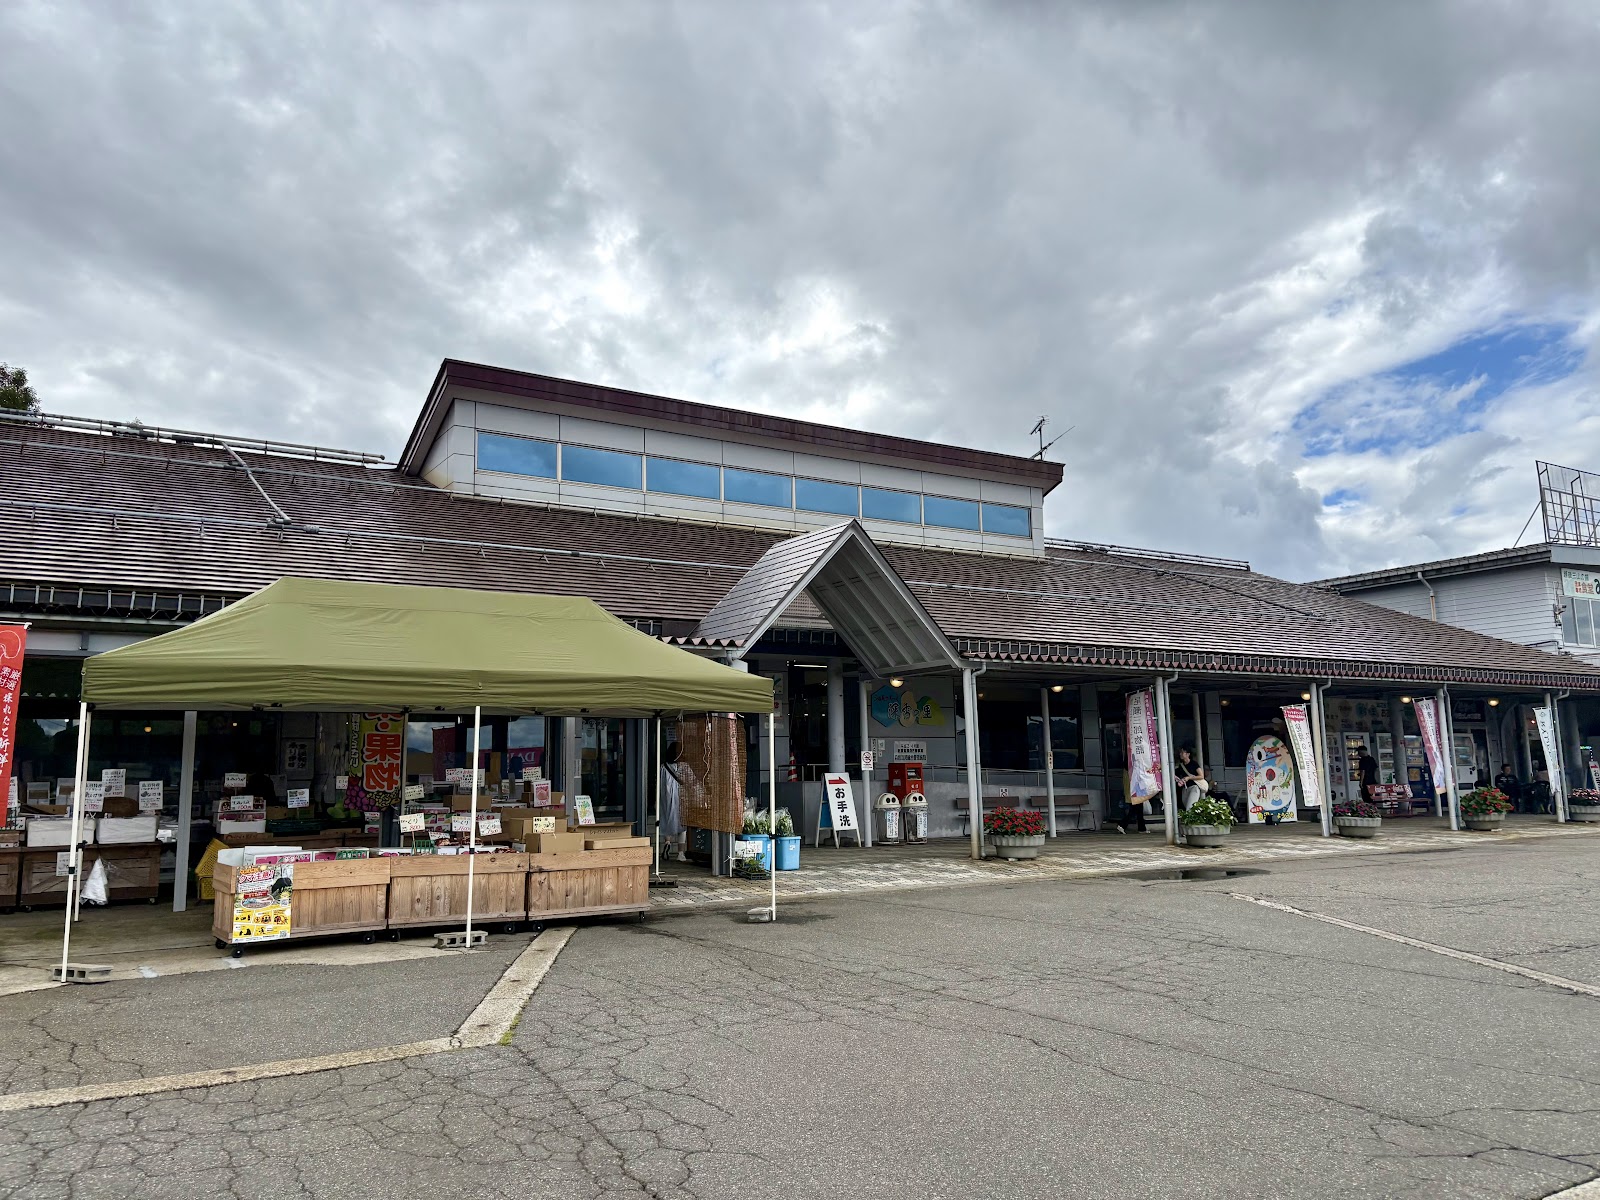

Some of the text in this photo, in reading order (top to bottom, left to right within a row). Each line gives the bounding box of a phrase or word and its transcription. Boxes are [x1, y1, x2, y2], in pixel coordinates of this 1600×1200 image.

[361, 713, 402, 792] ・果物
[834, 787, 851, 827] お手洗
